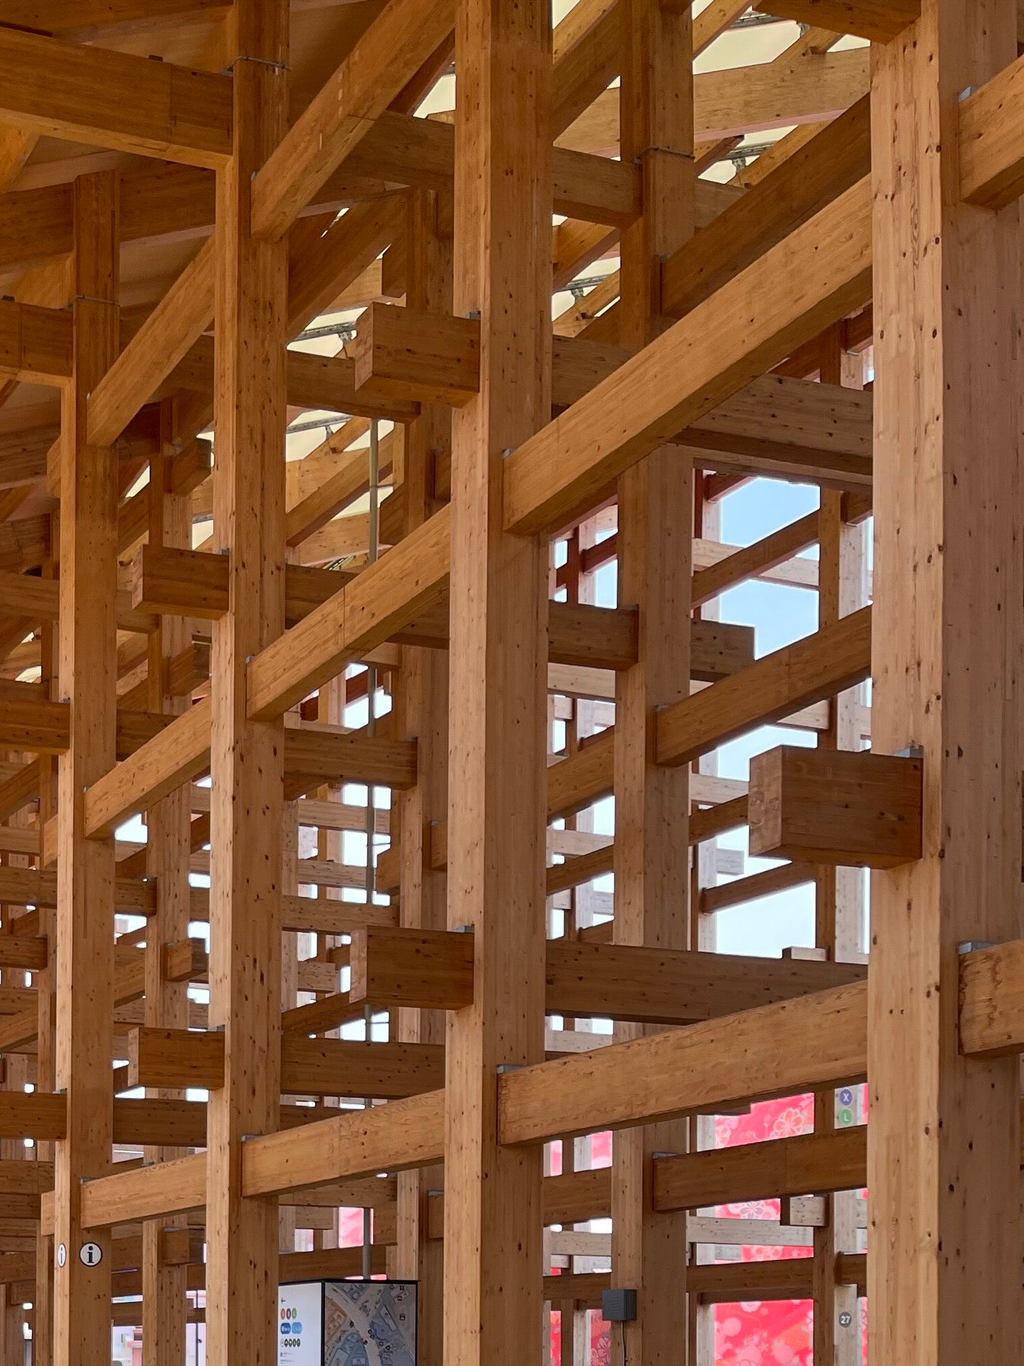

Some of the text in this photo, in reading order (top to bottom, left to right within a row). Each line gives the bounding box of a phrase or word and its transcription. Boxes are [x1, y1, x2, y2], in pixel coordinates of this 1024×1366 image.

[843, 1093, 850, 1102] X
[844, 1113, 849, 1122] L
[840, 1315, 851, 1324] 27
